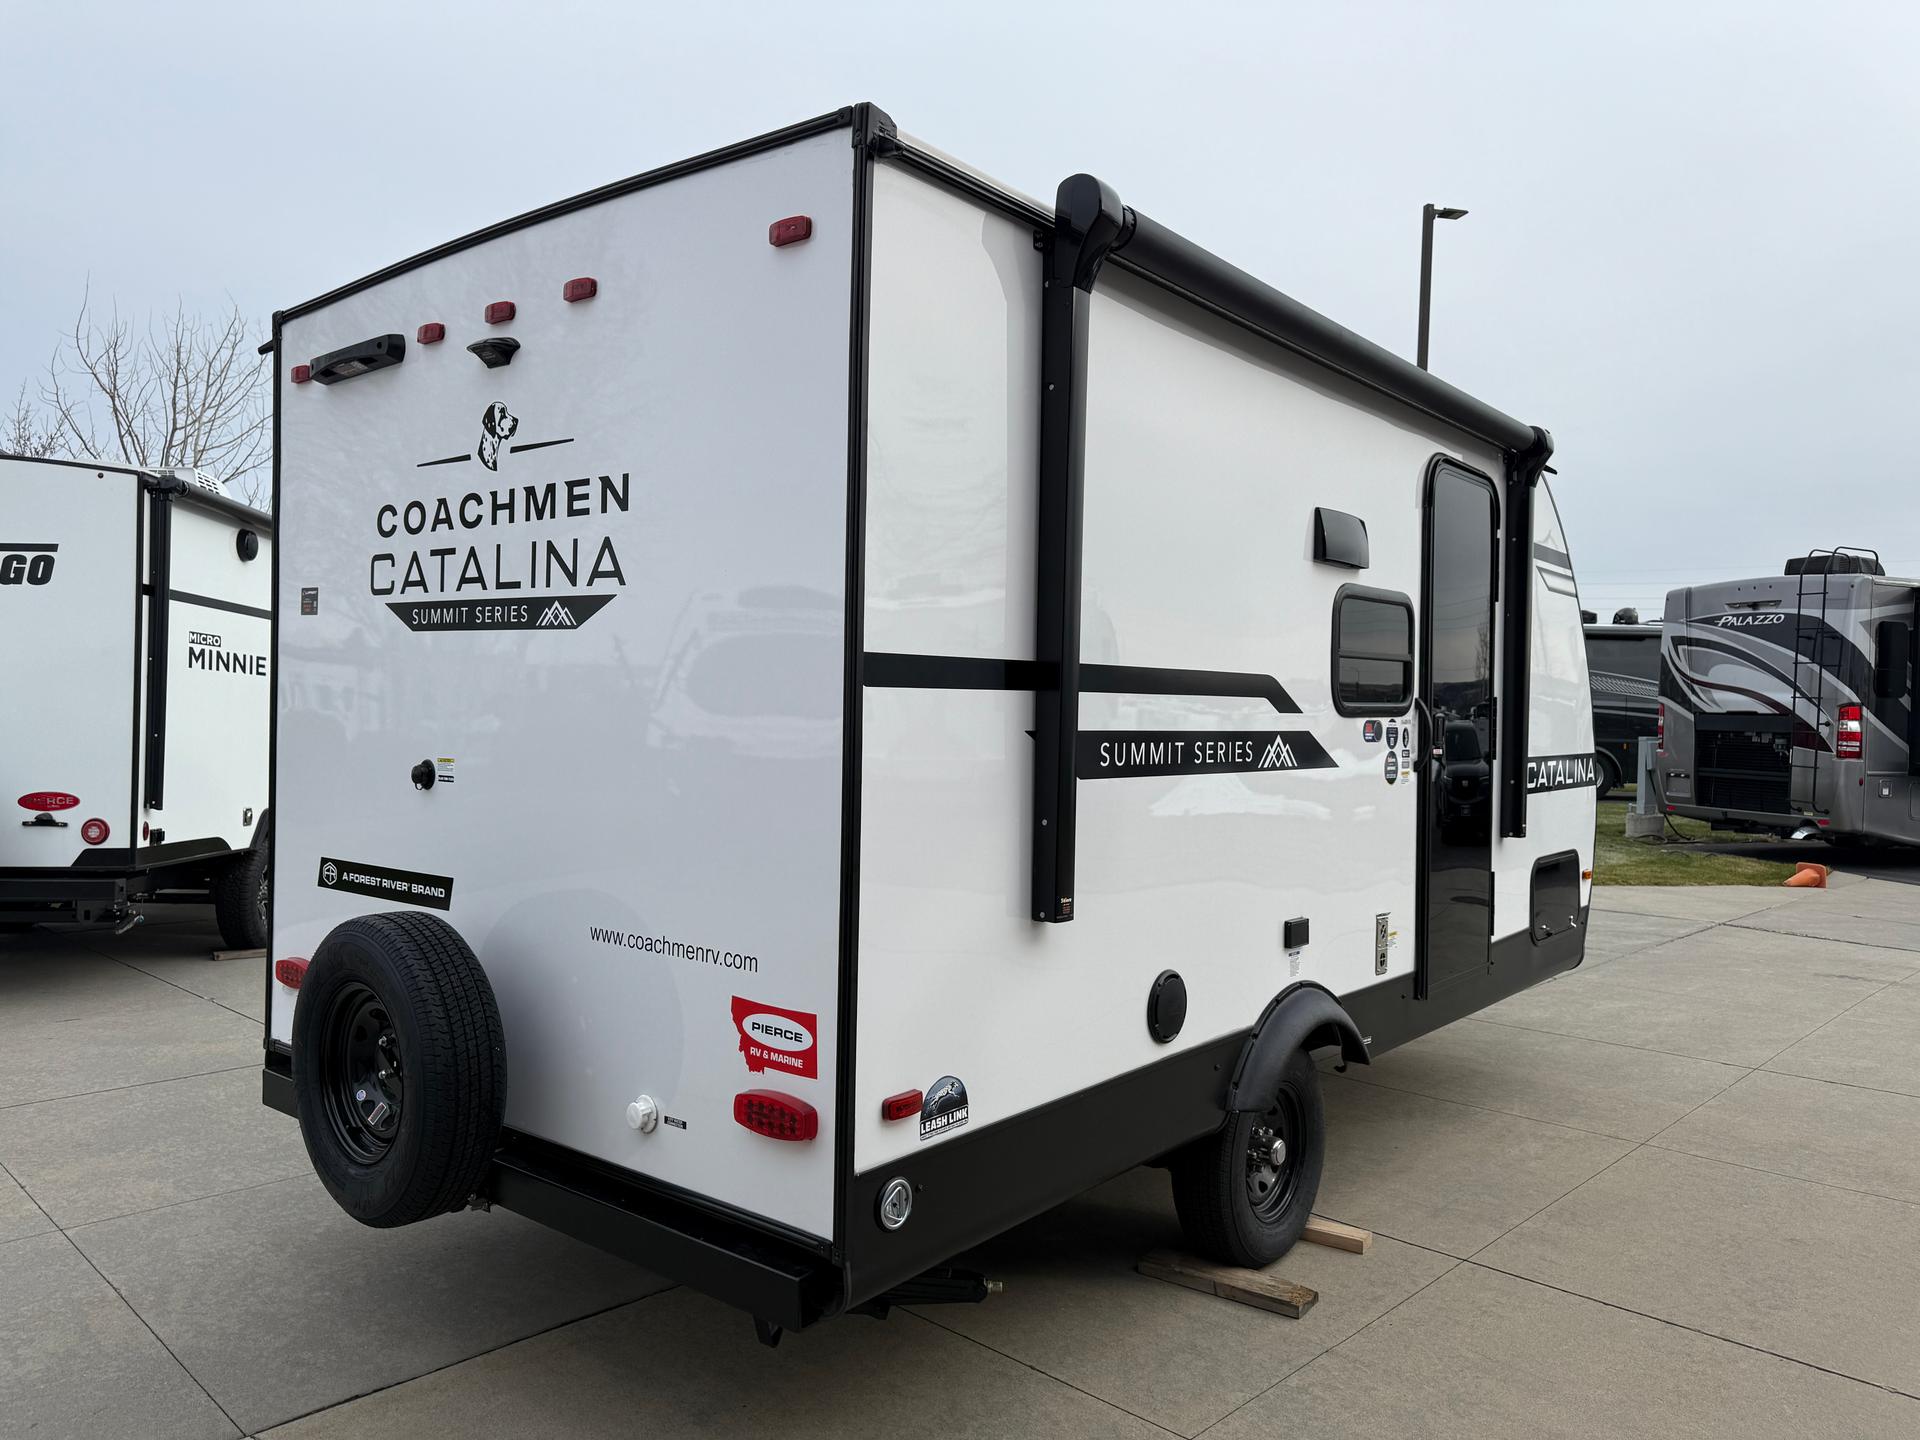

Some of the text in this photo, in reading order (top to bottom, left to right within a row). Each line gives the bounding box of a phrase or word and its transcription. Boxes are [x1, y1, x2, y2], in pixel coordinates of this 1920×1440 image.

[377, 473, 629, 538] COACHMEN
[371, 536, 626, 595] CATALINA
[412, 605, 528, 624] SUMMIT SERIES
[1717, 614, 1785, 626] PALAZZO
[189, 633, 221, 646] MICRO
[188, 647, 266, 676] MINNIE
[1100, 741, 1253, 766] SUMMIT SERIES
[1526, 757, 1595, 788] CATALINA
[342, 872, 348, 881] A
[349, 873, 381, 887] FOREST
[411, 883, 445, 898] BRAND
[590, 926, 758, 972] www.coachmenrv.com
[751, 1022, 803, 1043] PIERCE
[750, 1046, 803, 1068] RV & MARINE
[921, 1114, 948, 1134] LEASH
[949, 1107, 968, 1123] LINK
